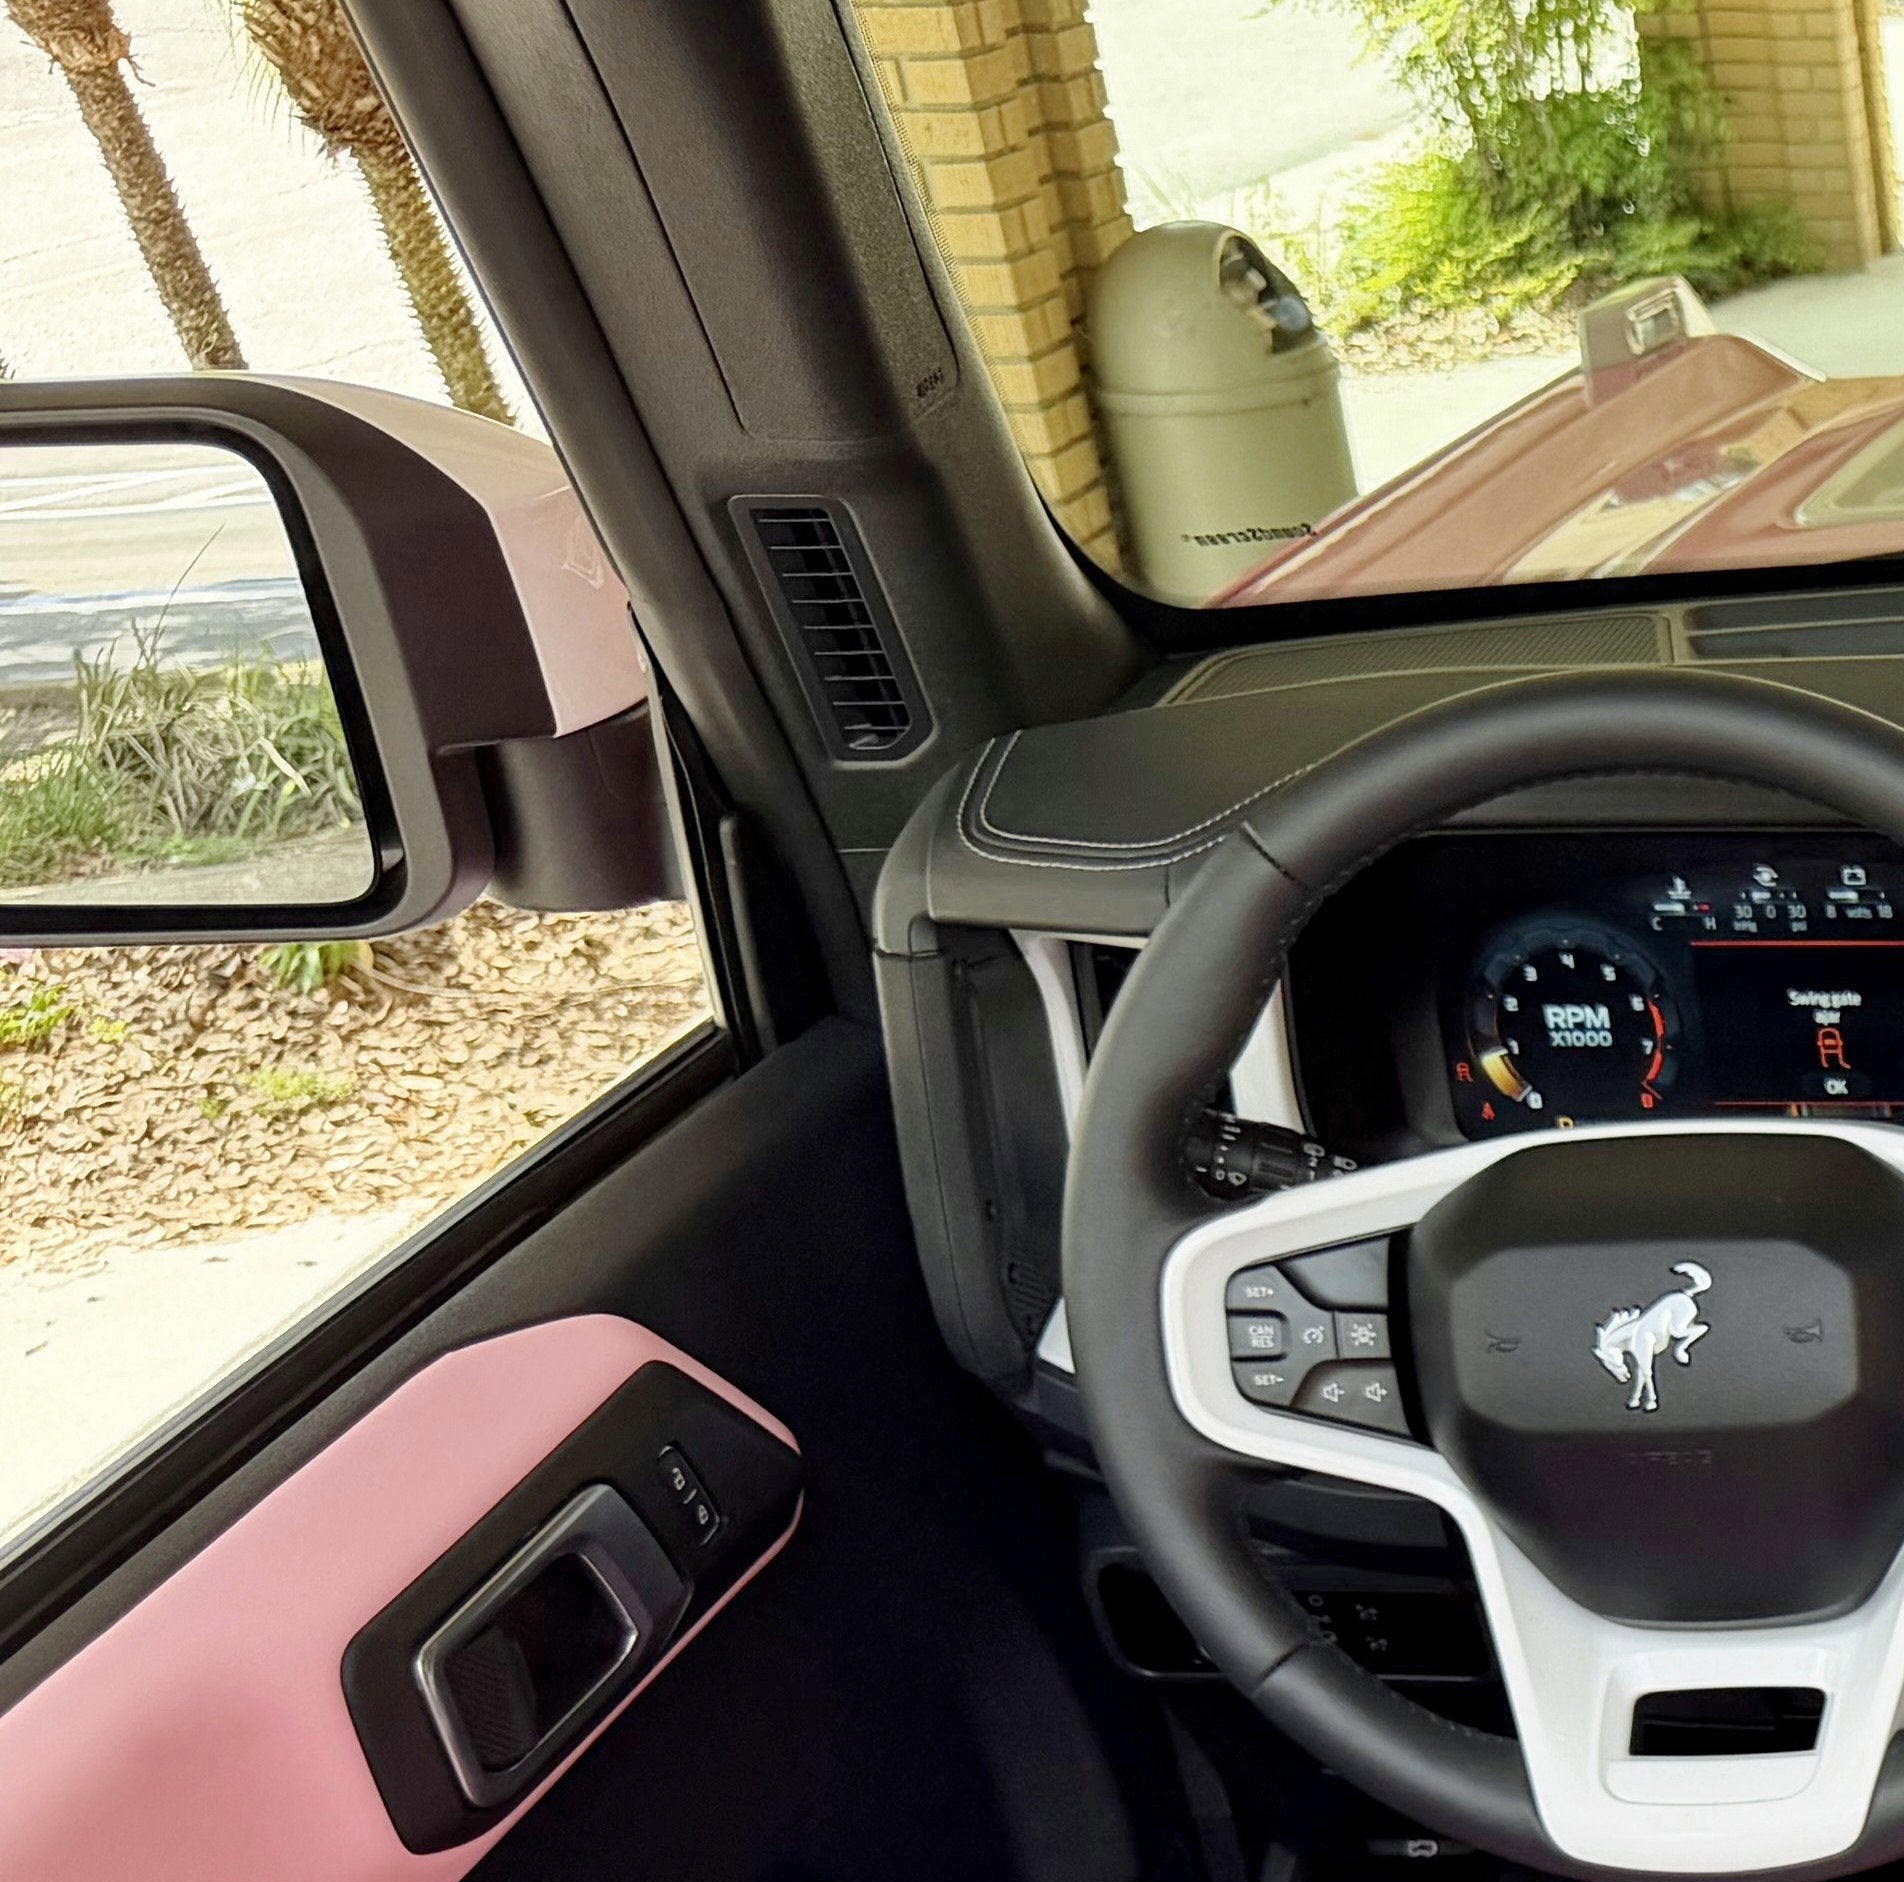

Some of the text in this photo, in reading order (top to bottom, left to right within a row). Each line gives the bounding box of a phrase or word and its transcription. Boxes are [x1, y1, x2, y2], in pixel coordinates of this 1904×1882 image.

[1651, 916, 1717, 931] C H
[1558, 951, 1575, 969] 4
[1522, 964, 1538, 982] 3
[1600, 963, 1616, 982] 5
[1503, 994, 1519, 1012] 2
[1543, 1003, 1611, 1030] RPM
[1507, 1038, 1520, 1055] 1
[1549, 1030, 1613, 1048] X1000
[1641, 1038, 1654, 1056] 7
[1824, 1078, 1848, 1095] OK
[1249, 1325, 1275, 1337] CAN
